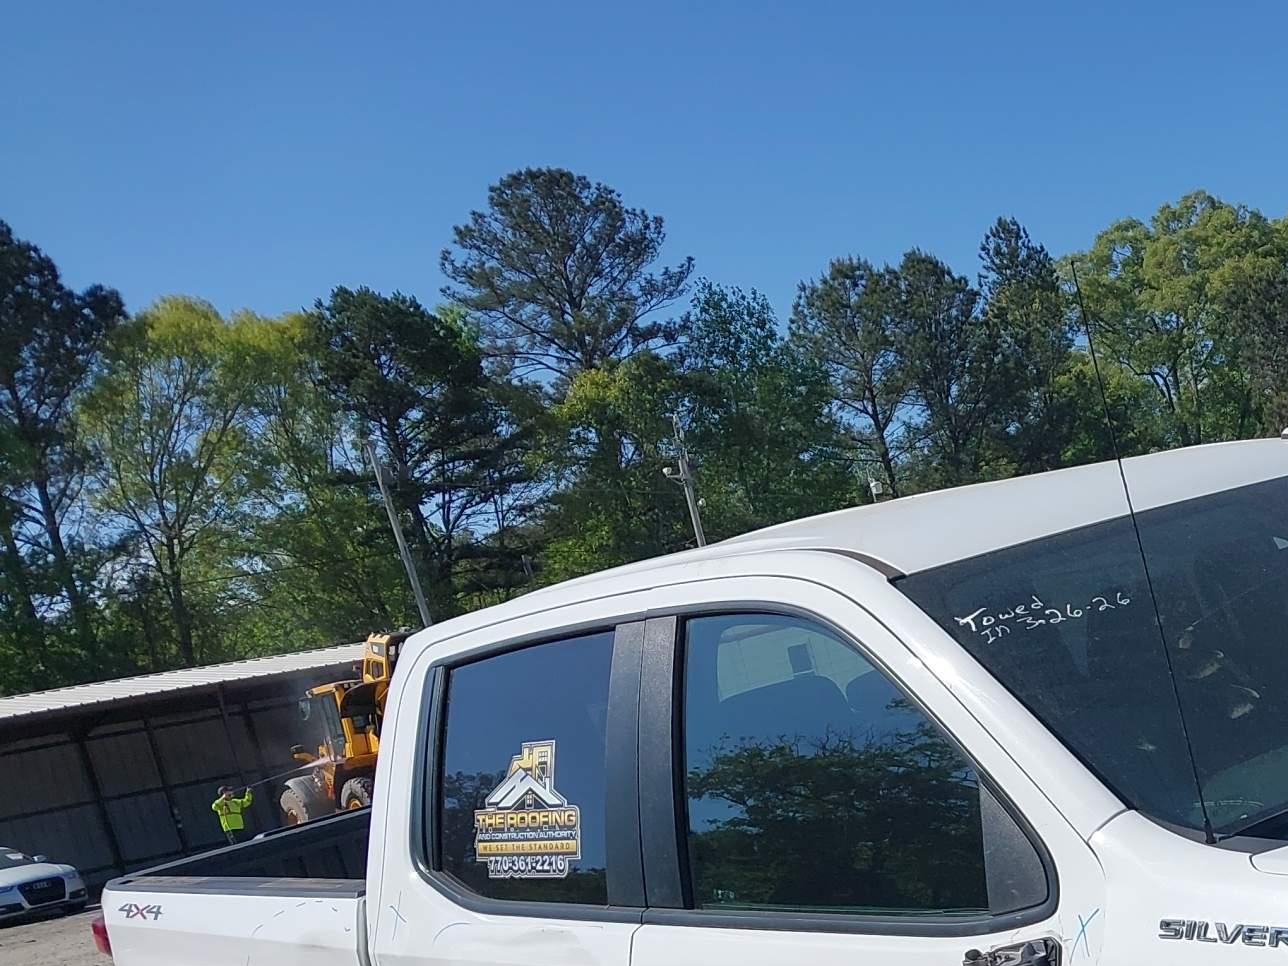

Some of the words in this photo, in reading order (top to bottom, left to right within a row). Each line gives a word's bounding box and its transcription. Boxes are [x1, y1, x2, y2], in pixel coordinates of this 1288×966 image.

[954, 595, 1044, 632] Towed
[478, 814, 505, 829] THE
[508, 811, 577, 828] ROOFING
[491, 831, 538, 841] CONSTRUCTION
[539, 829, 577, 839] AUTHORITY
[495, 844, 508, 852] SET
[511, 843, 526, 851] THE
[528, 842, 571, 851] STANDARD
[490, 856, 564, 871] 770-361-2216
